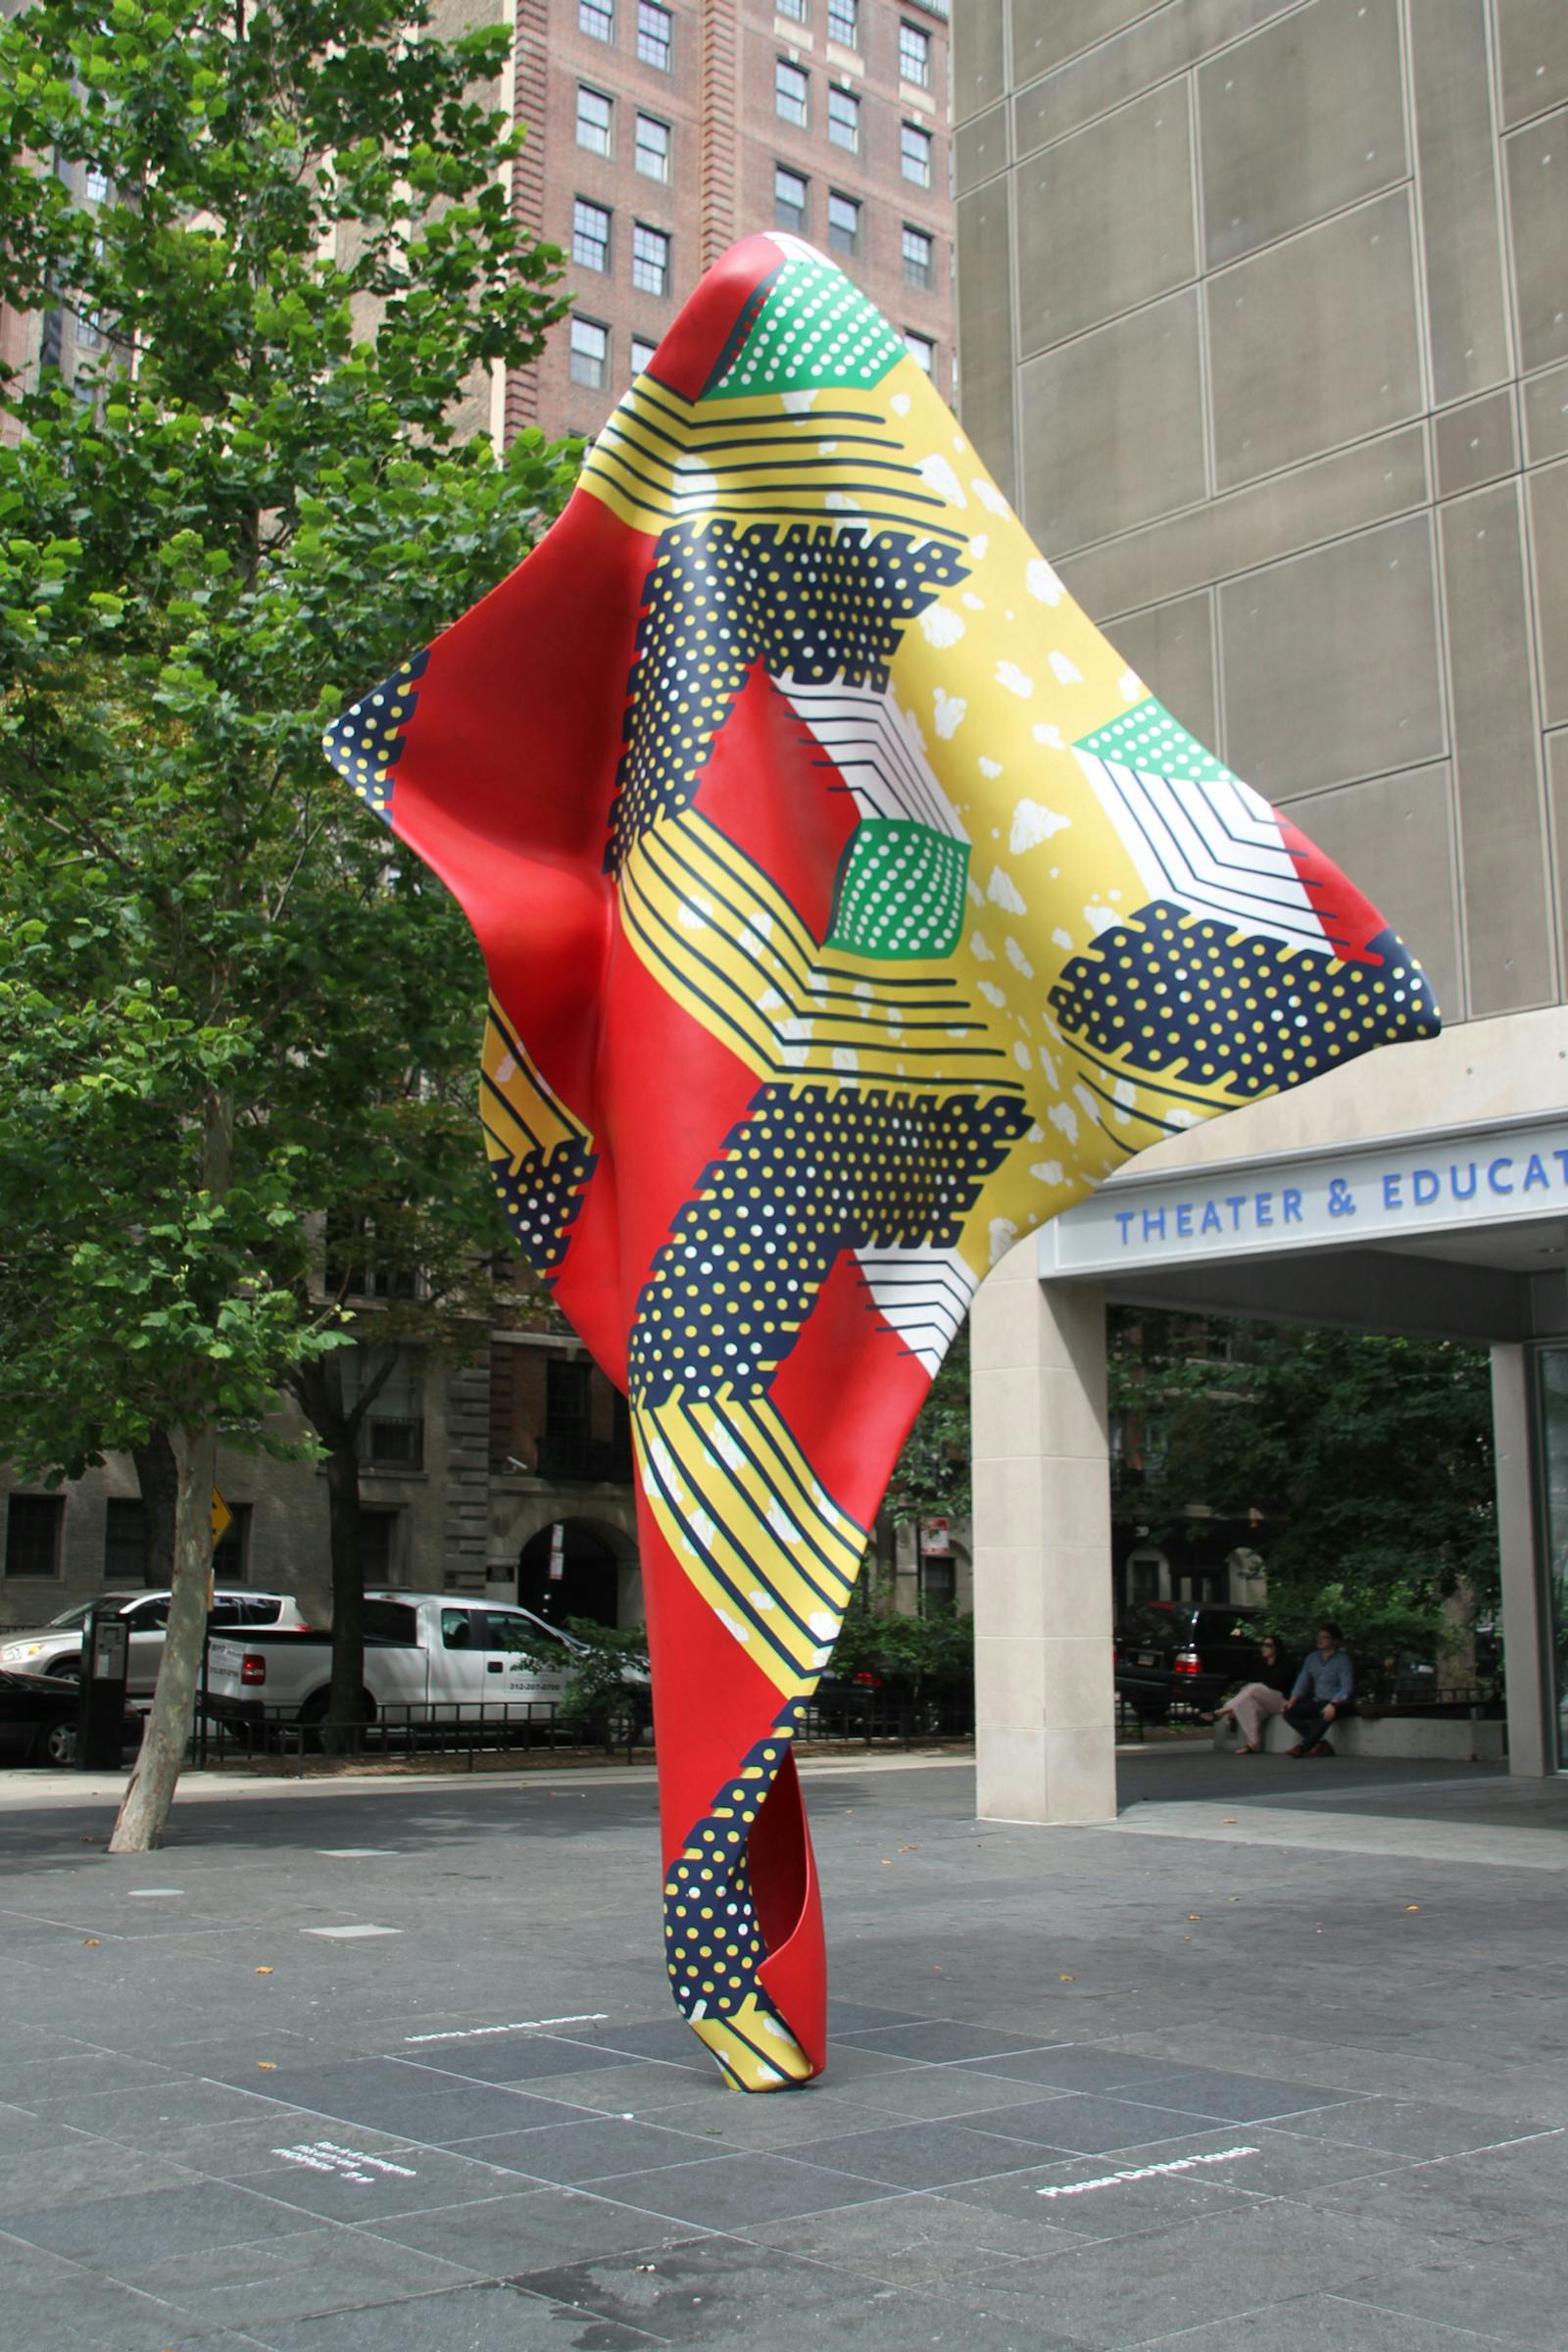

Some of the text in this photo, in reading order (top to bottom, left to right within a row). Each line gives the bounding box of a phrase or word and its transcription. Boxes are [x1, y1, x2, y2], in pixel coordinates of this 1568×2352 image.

[1113, 1148, 1568, 1245] THEATER & EDUCAT
[1036, 2146, 1261, 2198] Please Do Not Touch
